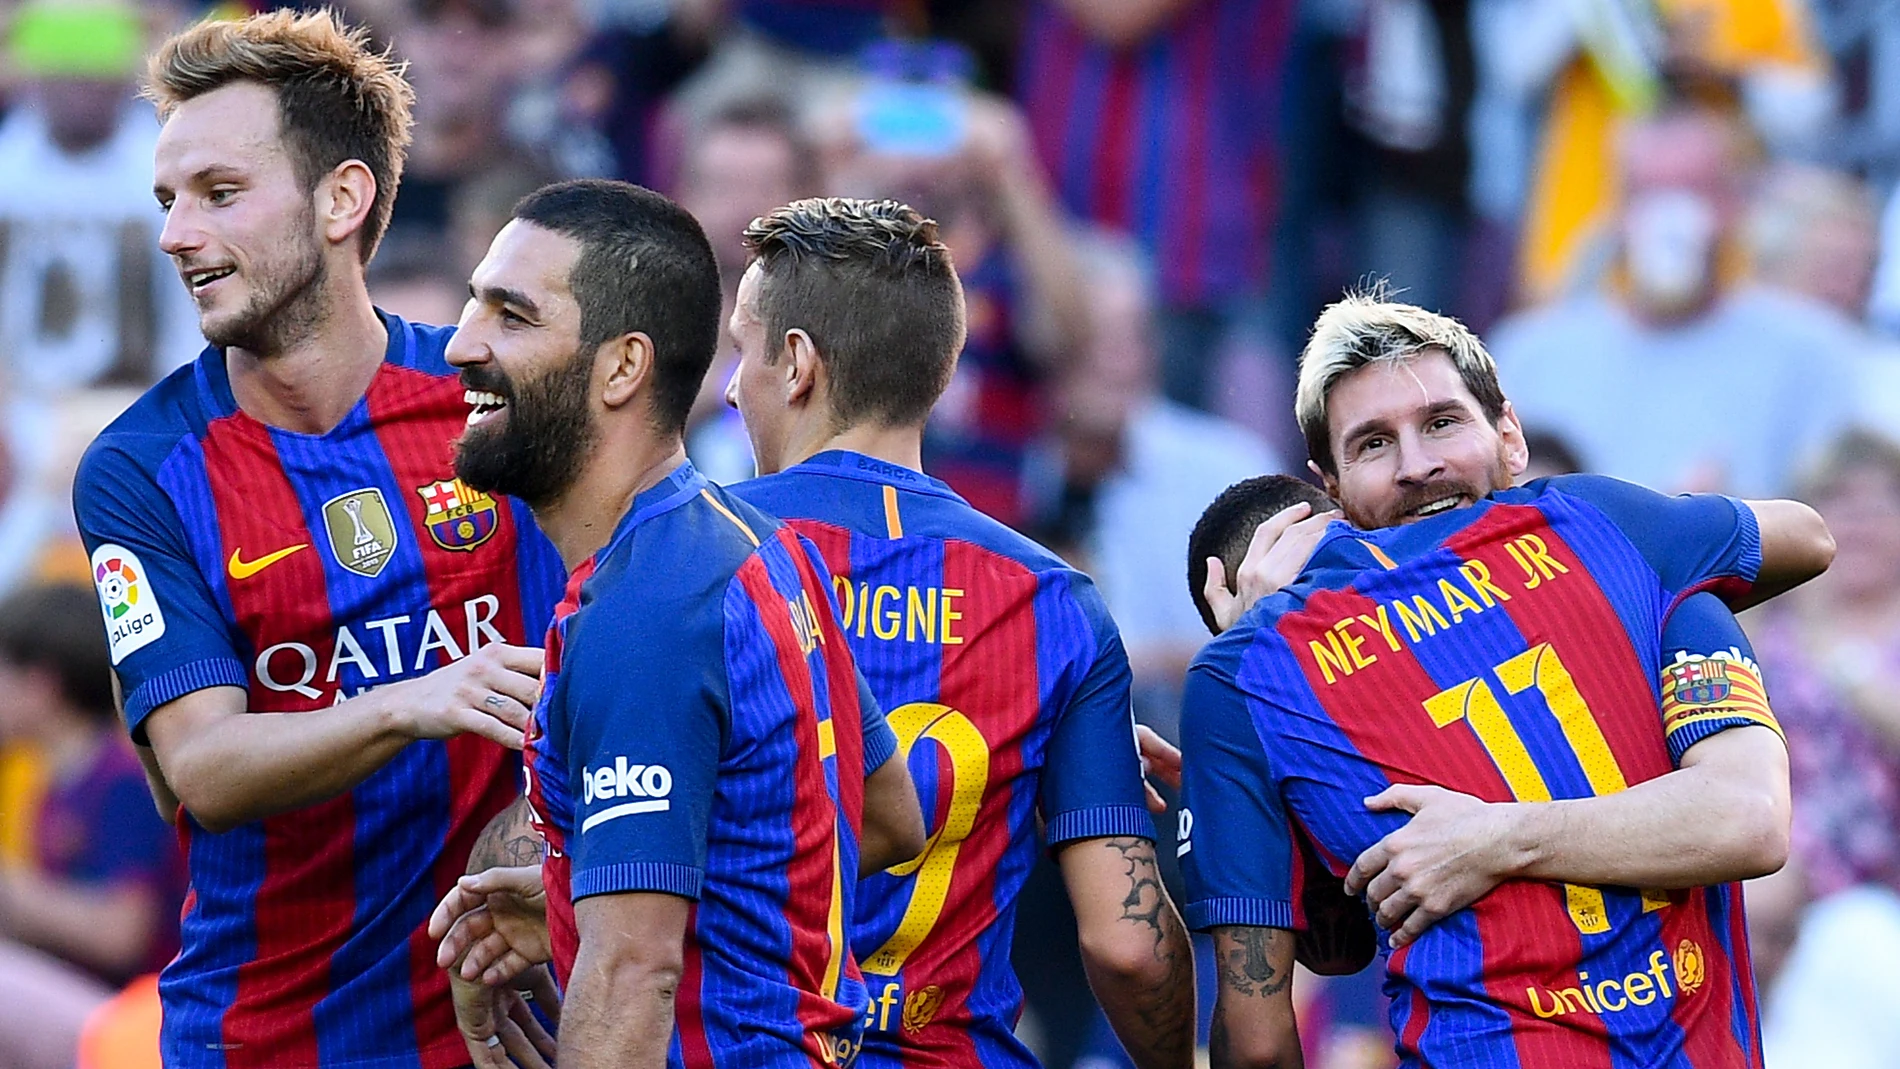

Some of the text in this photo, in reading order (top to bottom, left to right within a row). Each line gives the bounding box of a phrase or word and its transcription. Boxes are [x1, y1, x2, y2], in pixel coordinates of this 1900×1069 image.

[446, 504, 474, 519] FCB
[353, 541, 382, 560] FIFA
[113, 612, 154, 648] aLiga
[833, 574, 964, 644] DIGNE
[1308, 534, 1570, 685] NEYMAR JR
[254, 594, 507, 700] QATAR
[582, 756, 673, 805] beko
[1421, 641, 1671, 934] 11
[1526, 950, 1673, 1018] unicef
